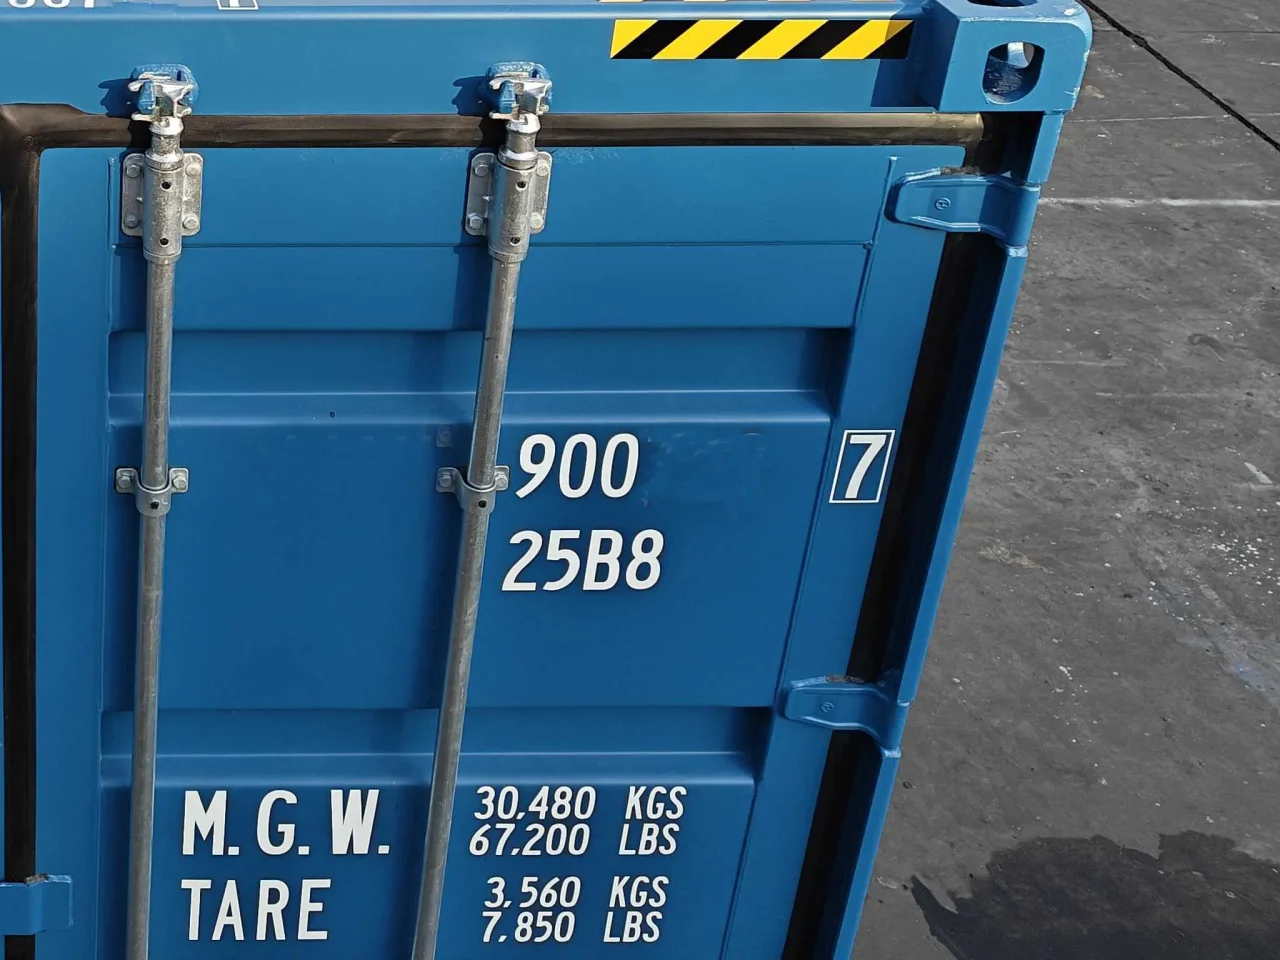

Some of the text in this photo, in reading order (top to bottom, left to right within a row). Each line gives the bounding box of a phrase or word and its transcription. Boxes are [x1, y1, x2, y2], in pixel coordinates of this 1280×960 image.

[515, 433, 887, 499] 900 7
[501, 529, 664, 591] 25B8
[474, 785, 596, 820] 30,480
[625, 785, 687, 820] KGS
[469, 823, 680, 856] 67,200 LBS
[181, 876, 669, 941] TARE 3,560 KGS
[482, 911, 663, 943] 7,850 LBS
